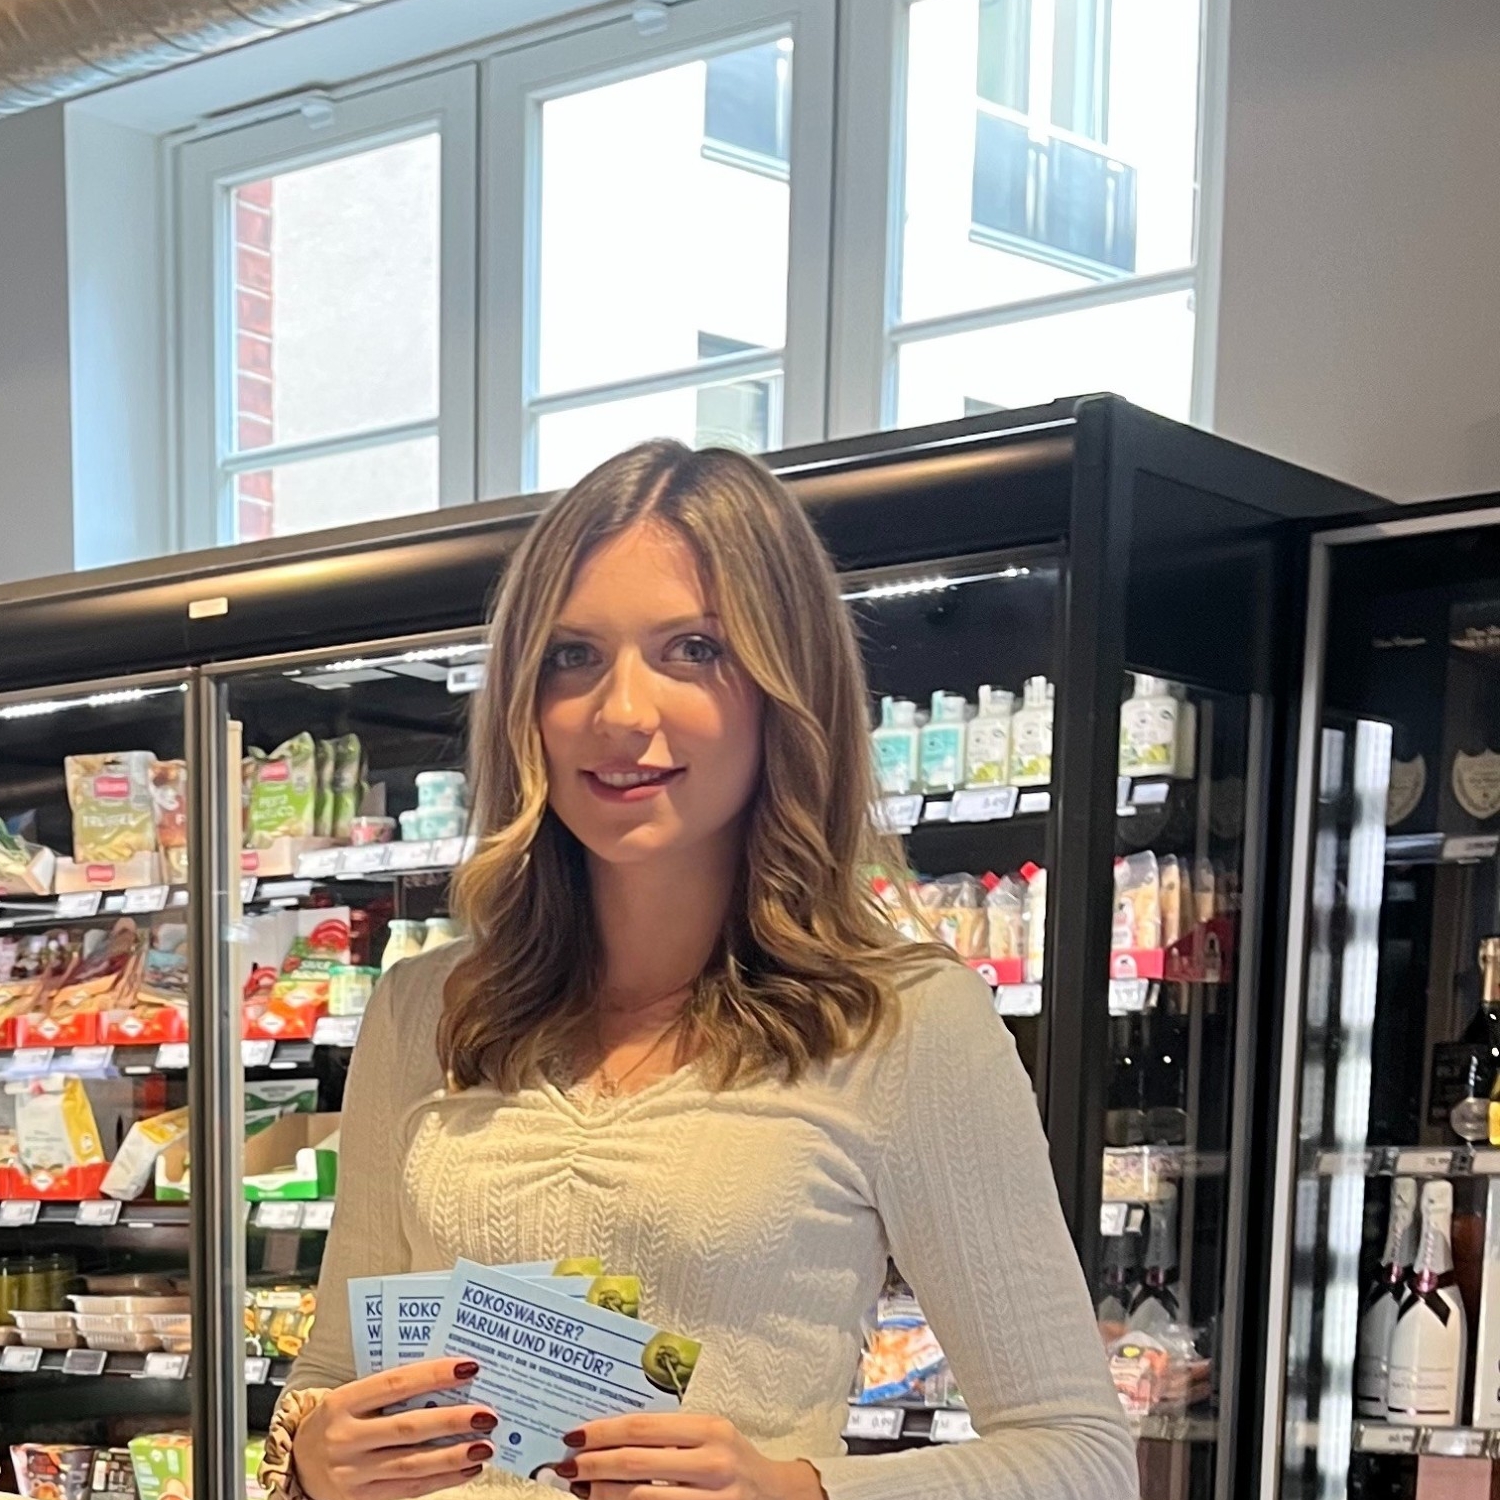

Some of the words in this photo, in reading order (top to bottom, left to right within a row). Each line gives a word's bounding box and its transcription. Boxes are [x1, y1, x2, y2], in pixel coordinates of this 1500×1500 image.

[456, 1308, 511, 1342] WARUM
[512, 1326, 546, 1353] UND
[548, 1343, 614, 1378] WOFÜR?
[461, 1285, 585, 1341] KOKOSWASSER?
